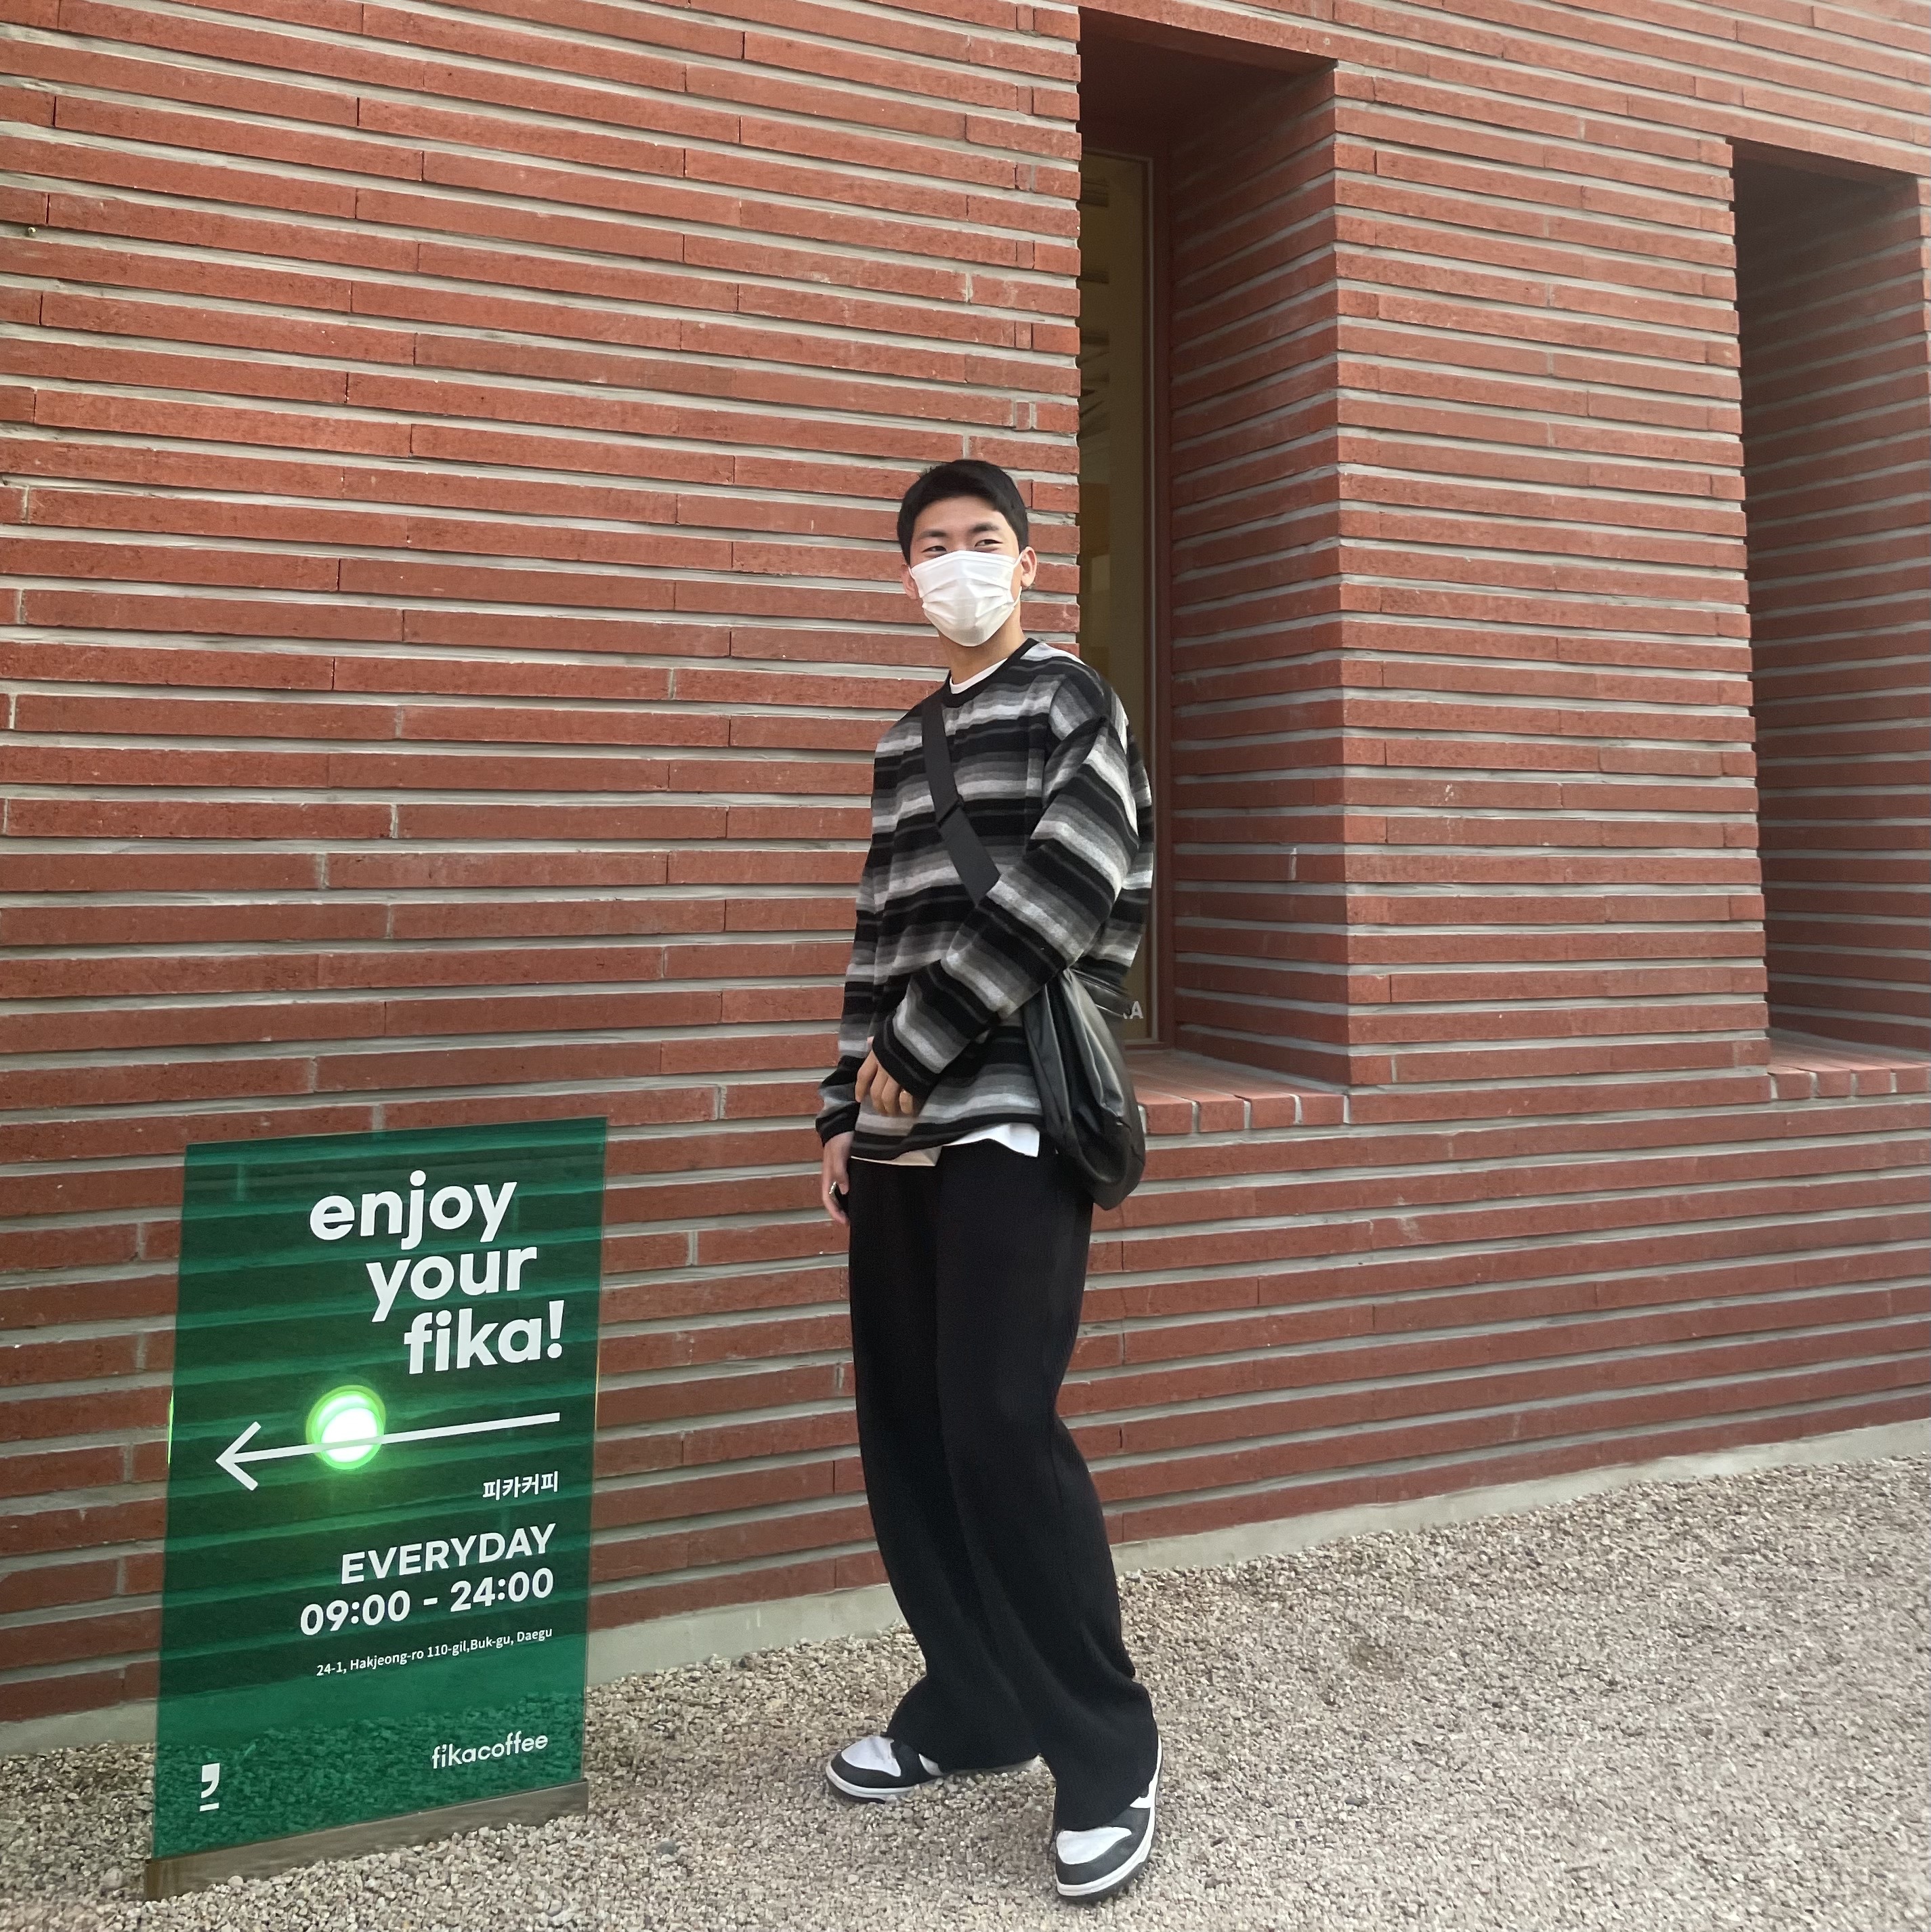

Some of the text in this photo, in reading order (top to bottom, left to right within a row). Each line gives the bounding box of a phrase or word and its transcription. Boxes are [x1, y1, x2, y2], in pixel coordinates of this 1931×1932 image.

[310, 1170, 517, 1250] enjoy
[366, 1246, 537, 1322] your
[404, 1300, 565, 1374] fika!
[482, 1471, 559, 1500] 피카커피
[341, 1523, 556, 1584] EVERYDAY
[300, 1568, 553, 1635] 09:00 - 24:00
[316, 1662, 347, 1677] 24-1,
[350, 1649, 424, 1671] Hakjeong-ro
[517, 1628, 553, 1642] Daegu
[431, 1731, 549, 1769] fikacoffee
